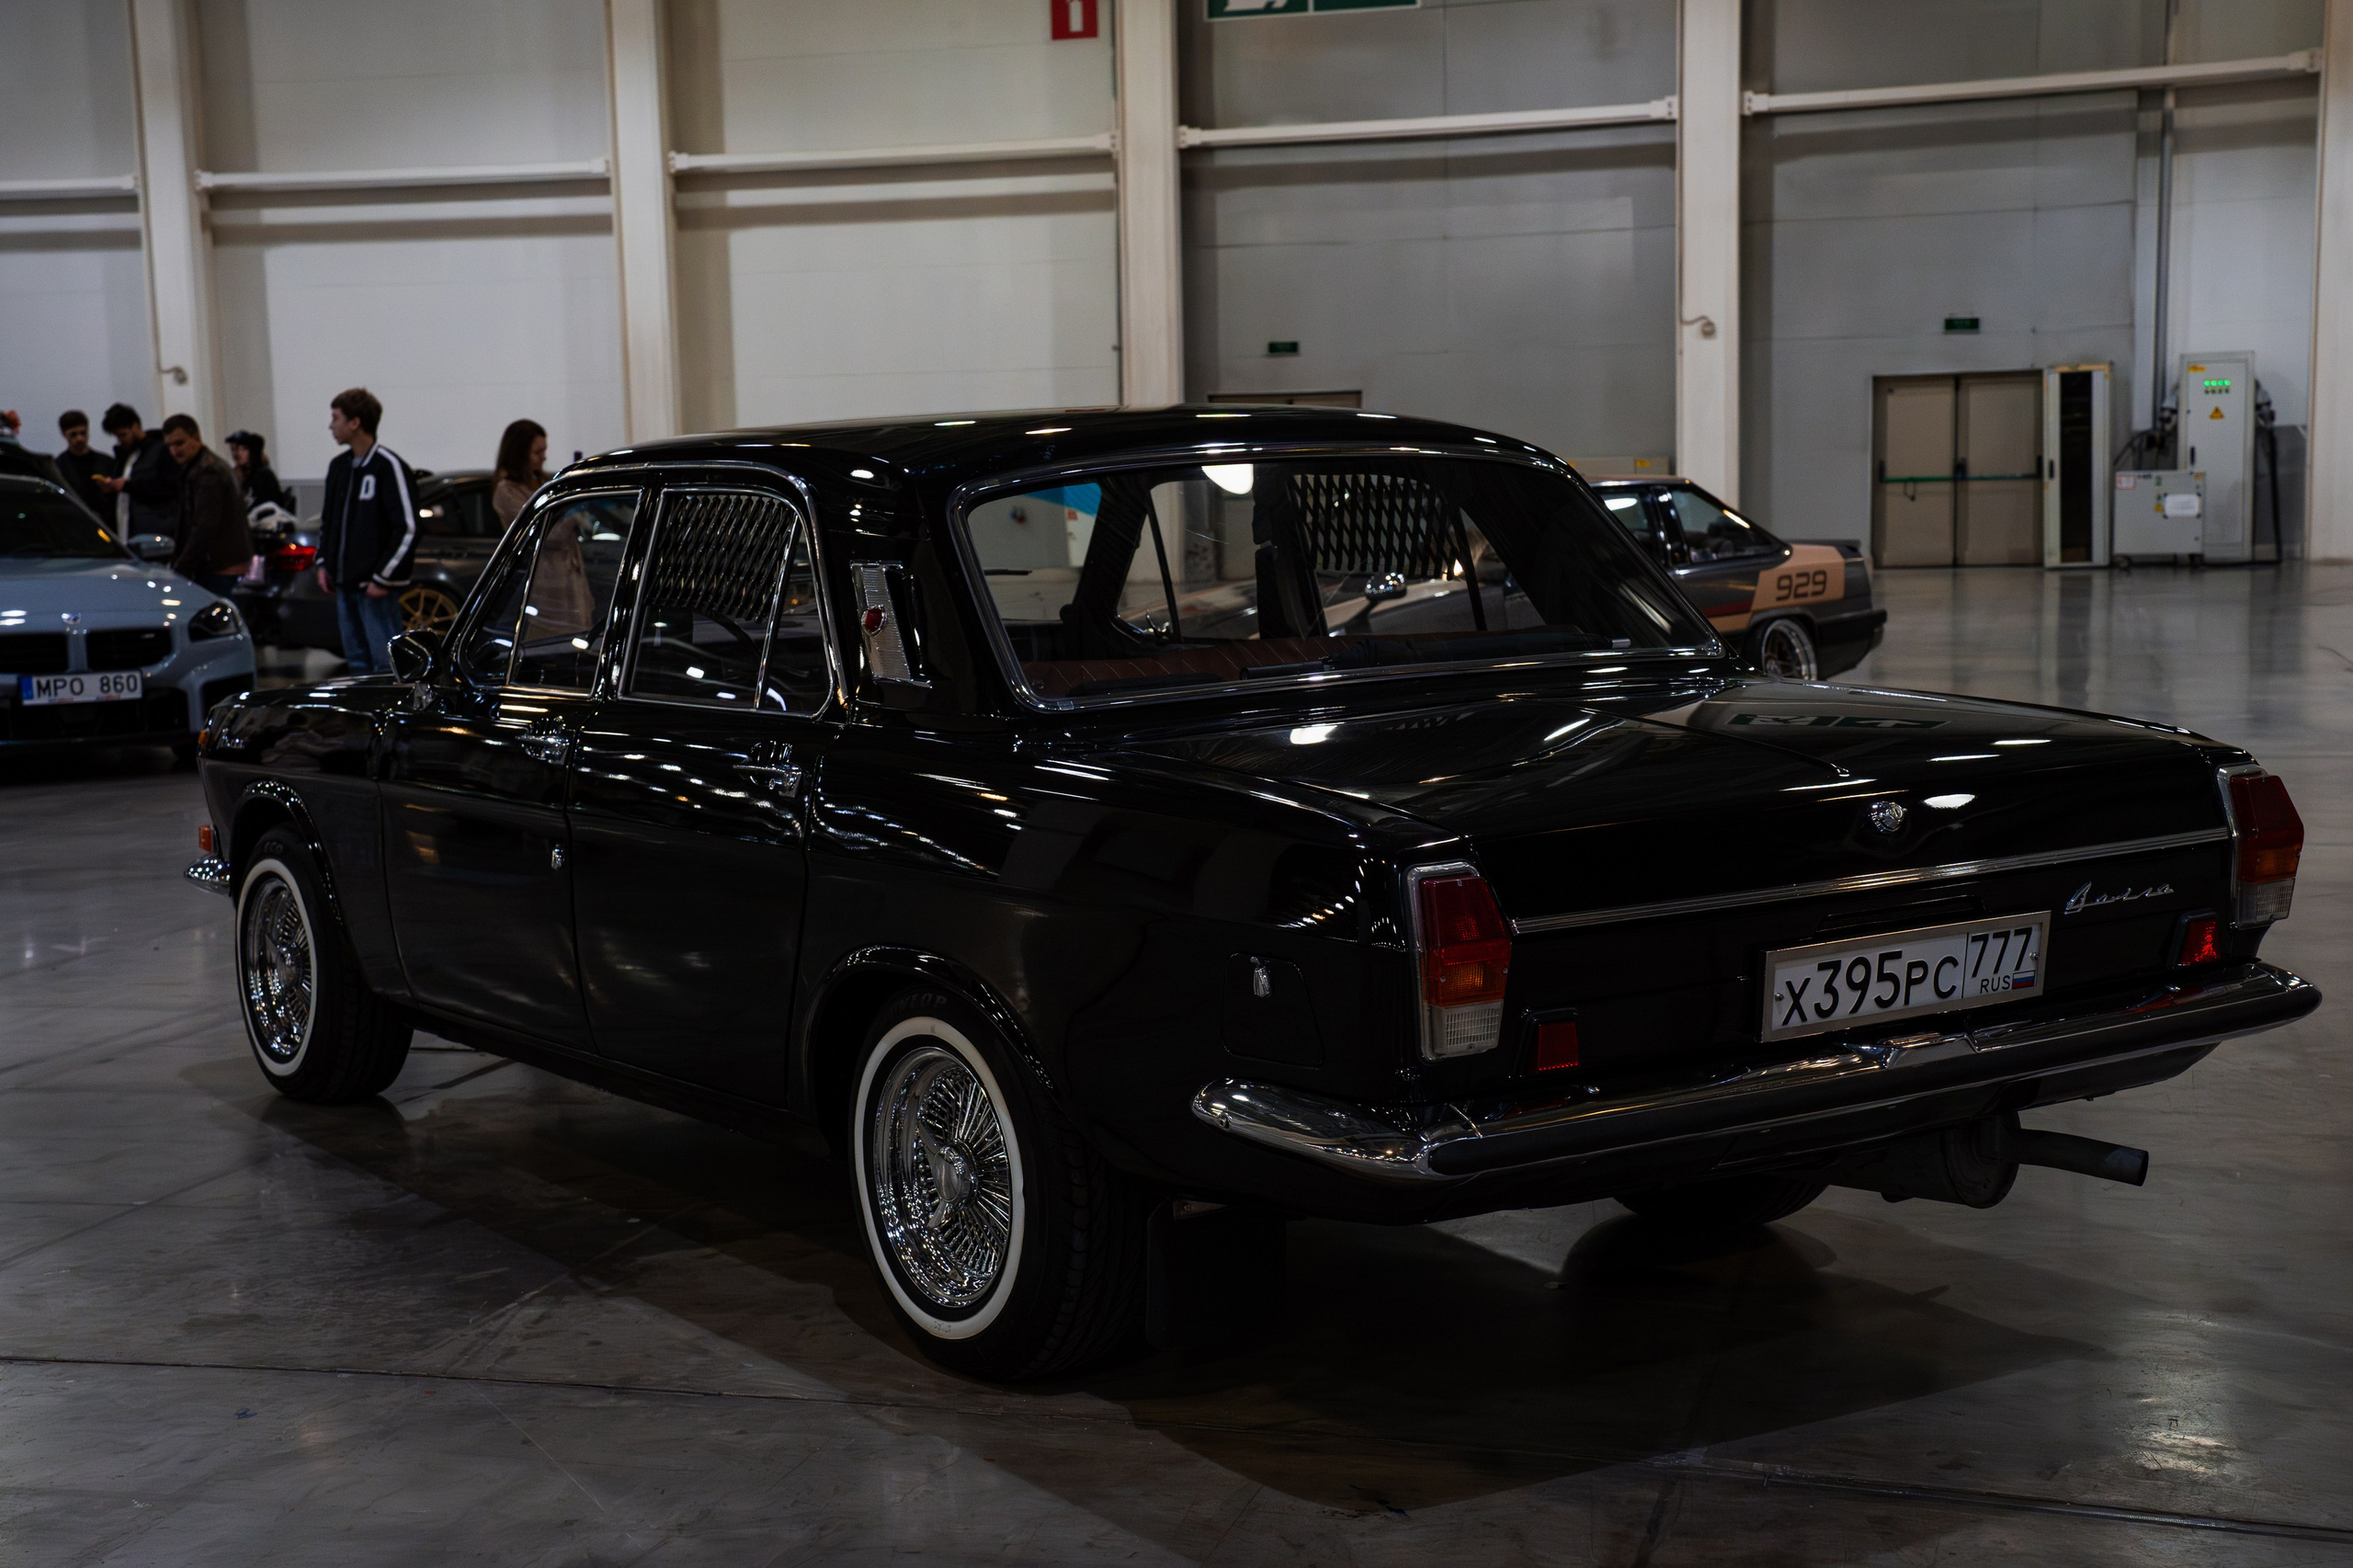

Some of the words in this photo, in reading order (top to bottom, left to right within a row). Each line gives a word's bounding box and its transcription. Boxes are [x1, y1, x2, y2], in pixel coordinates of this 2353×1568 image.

[358, 473, 377, 502] D
[1776, 570, 1827, 601] 929
[37, 678, 85, 699] MPO
[100, 675, 138, 694] 860
[1970, 927, 2033, 978] 777
[1980, 976, 2012, 994] RUS
